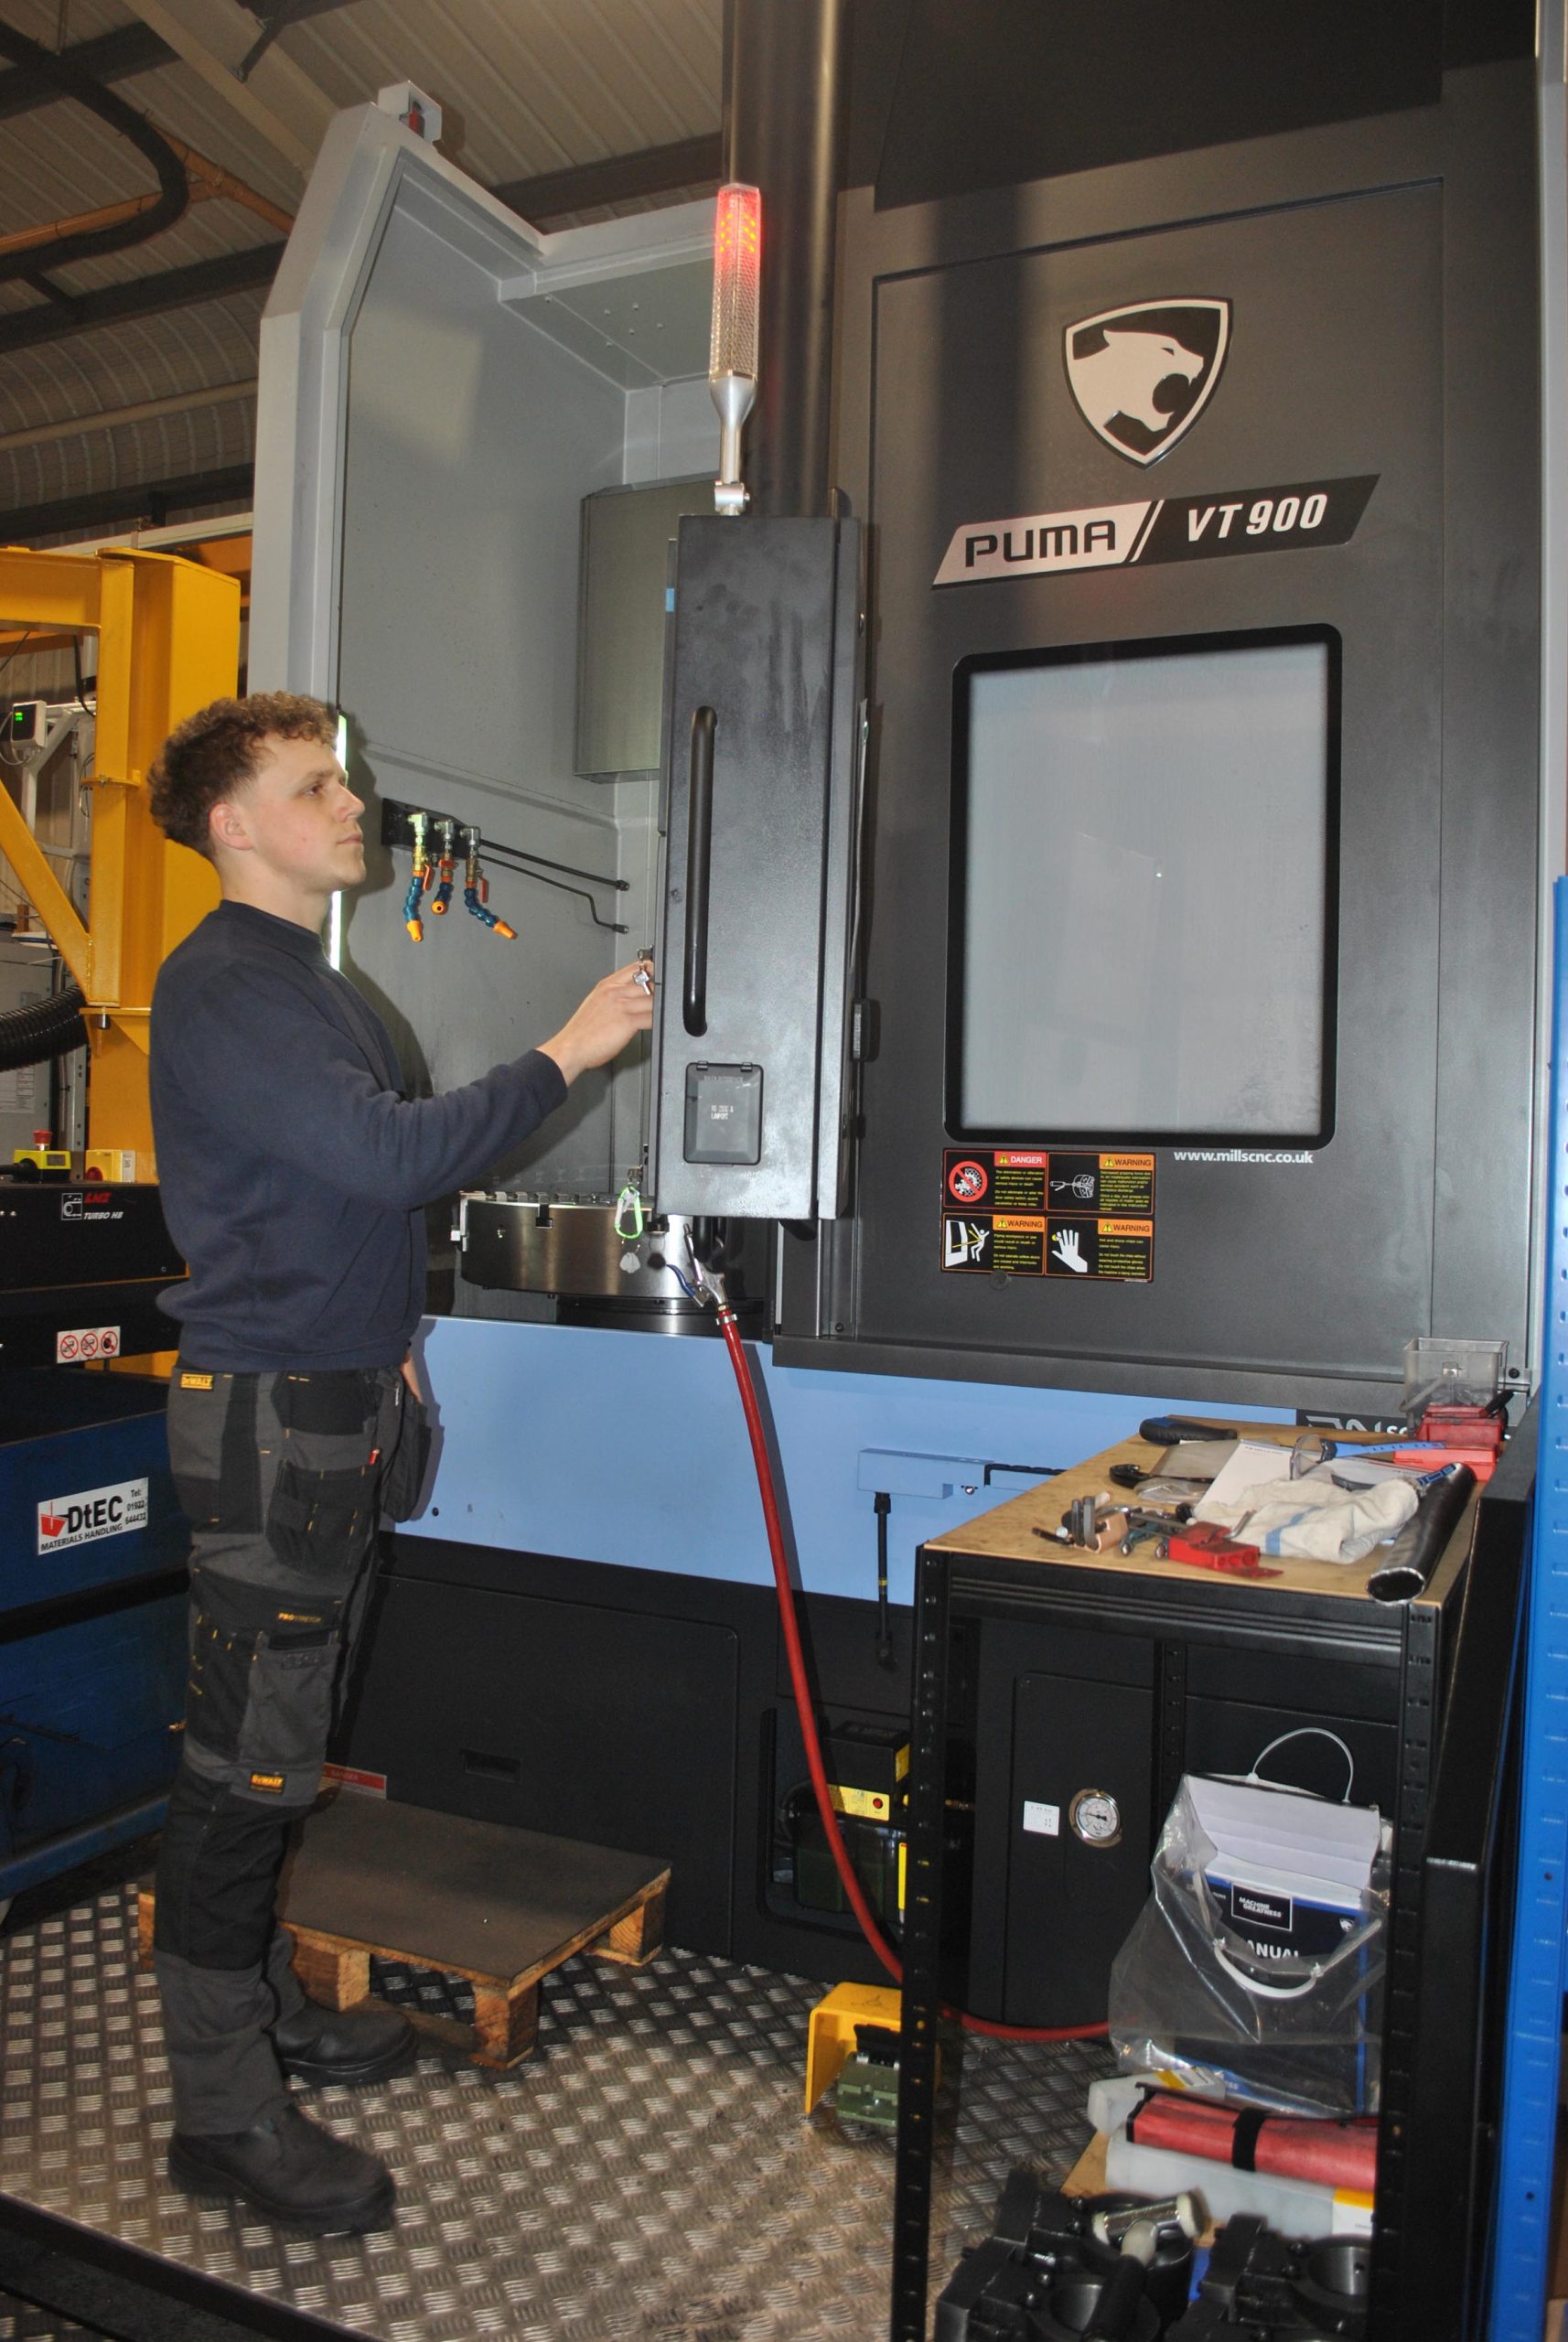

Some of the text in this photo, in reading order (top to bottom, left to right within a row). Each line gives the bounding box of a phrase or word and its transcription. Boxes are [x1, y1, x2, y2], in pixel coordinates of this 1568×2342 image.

[964, 519, 1116, 568] PUMA
[1010, 1155, 1043, 1165] DANGER
[1114, 1158, 1152, 1166] WARNING
[1173, 1149, 1314, 1164] www.millscnc.co.uk
[83, 1211, 111, 1220] TURBO
[1007, 1219, 1043, 1229] WARNING
[1112, 1223, 1150, 1232] WARNING
[67, 1495, 124, 1534] DtEC
[40, 1522, 124, 1552] MATERIALS HANDLING
[1239, 1896, 1271, 1910] MACHINE
[1242, 1903, 1283, 1918] GREATNESS
